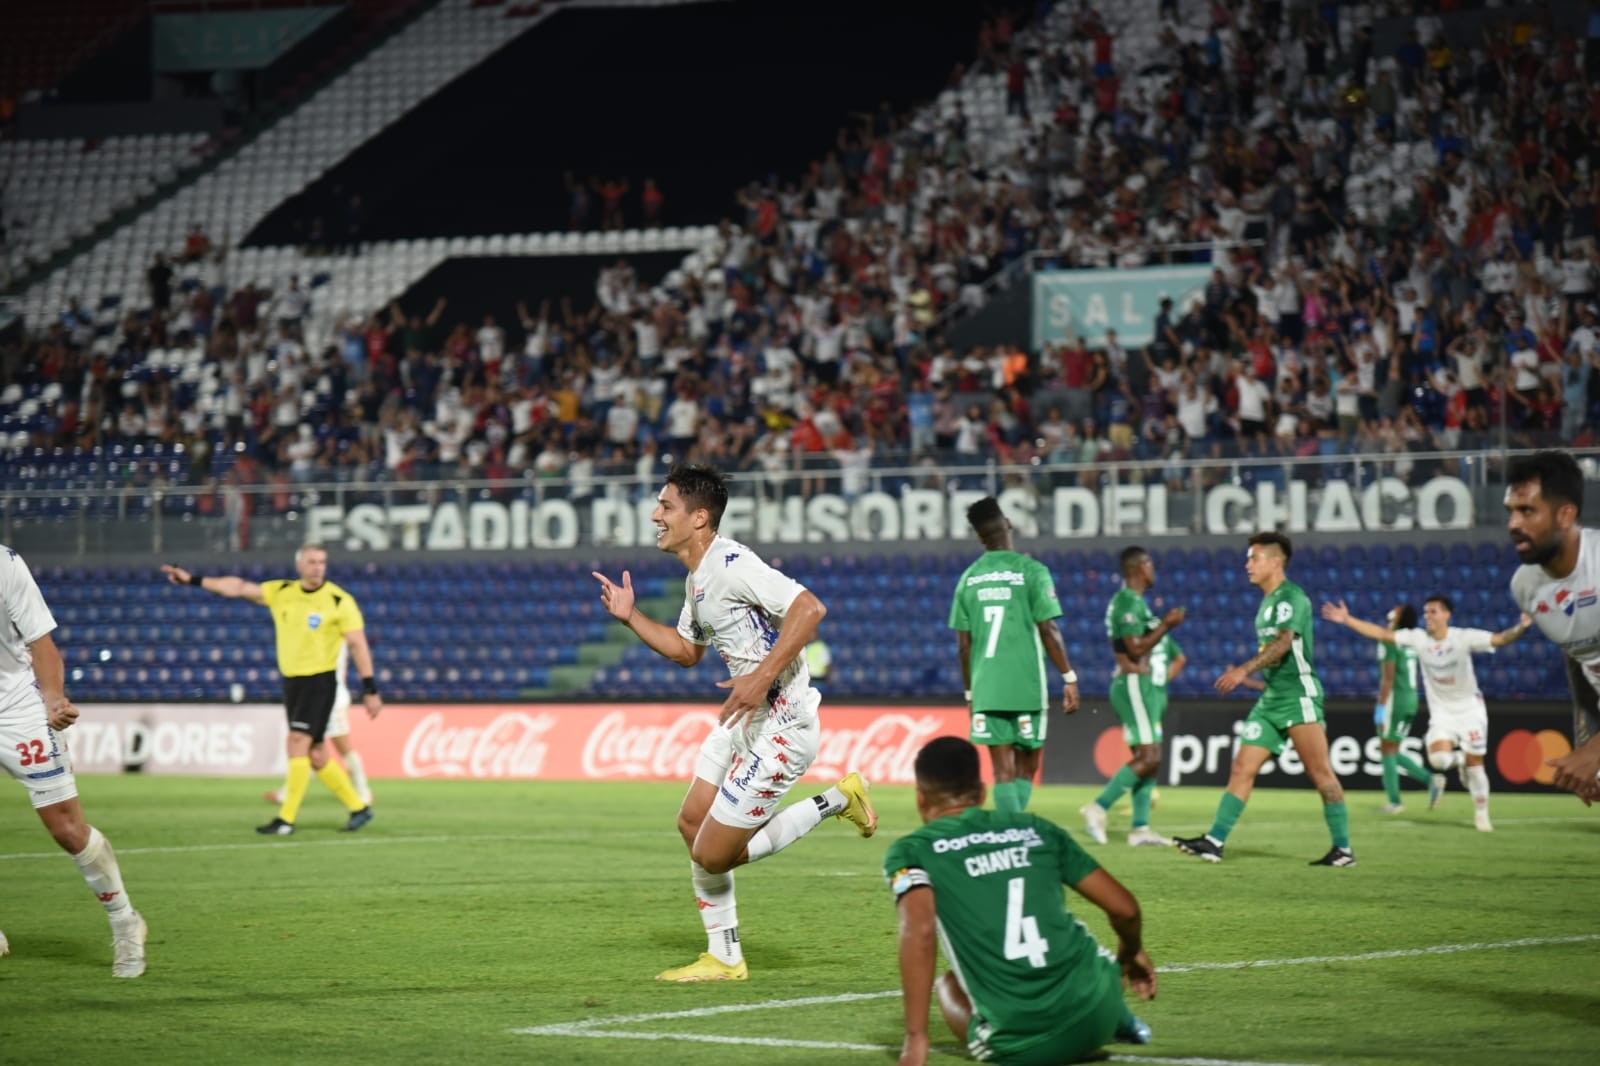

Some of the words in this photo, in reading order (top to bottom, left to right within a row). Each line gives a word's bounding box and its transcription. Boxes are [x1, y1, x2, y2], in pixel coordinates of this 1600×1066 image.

[306, 499, 579, 549] ESTADIO
[1054, 484, 1191, 538] DEL
[1205, 476, 1475, 534] CHACO
[983, 605, 1005, 658] 7
[16, 739, 48, 766] 32
[964, 846, 1032, 878] CHAVEZ
[1003, 876, 1049, 968] 4
